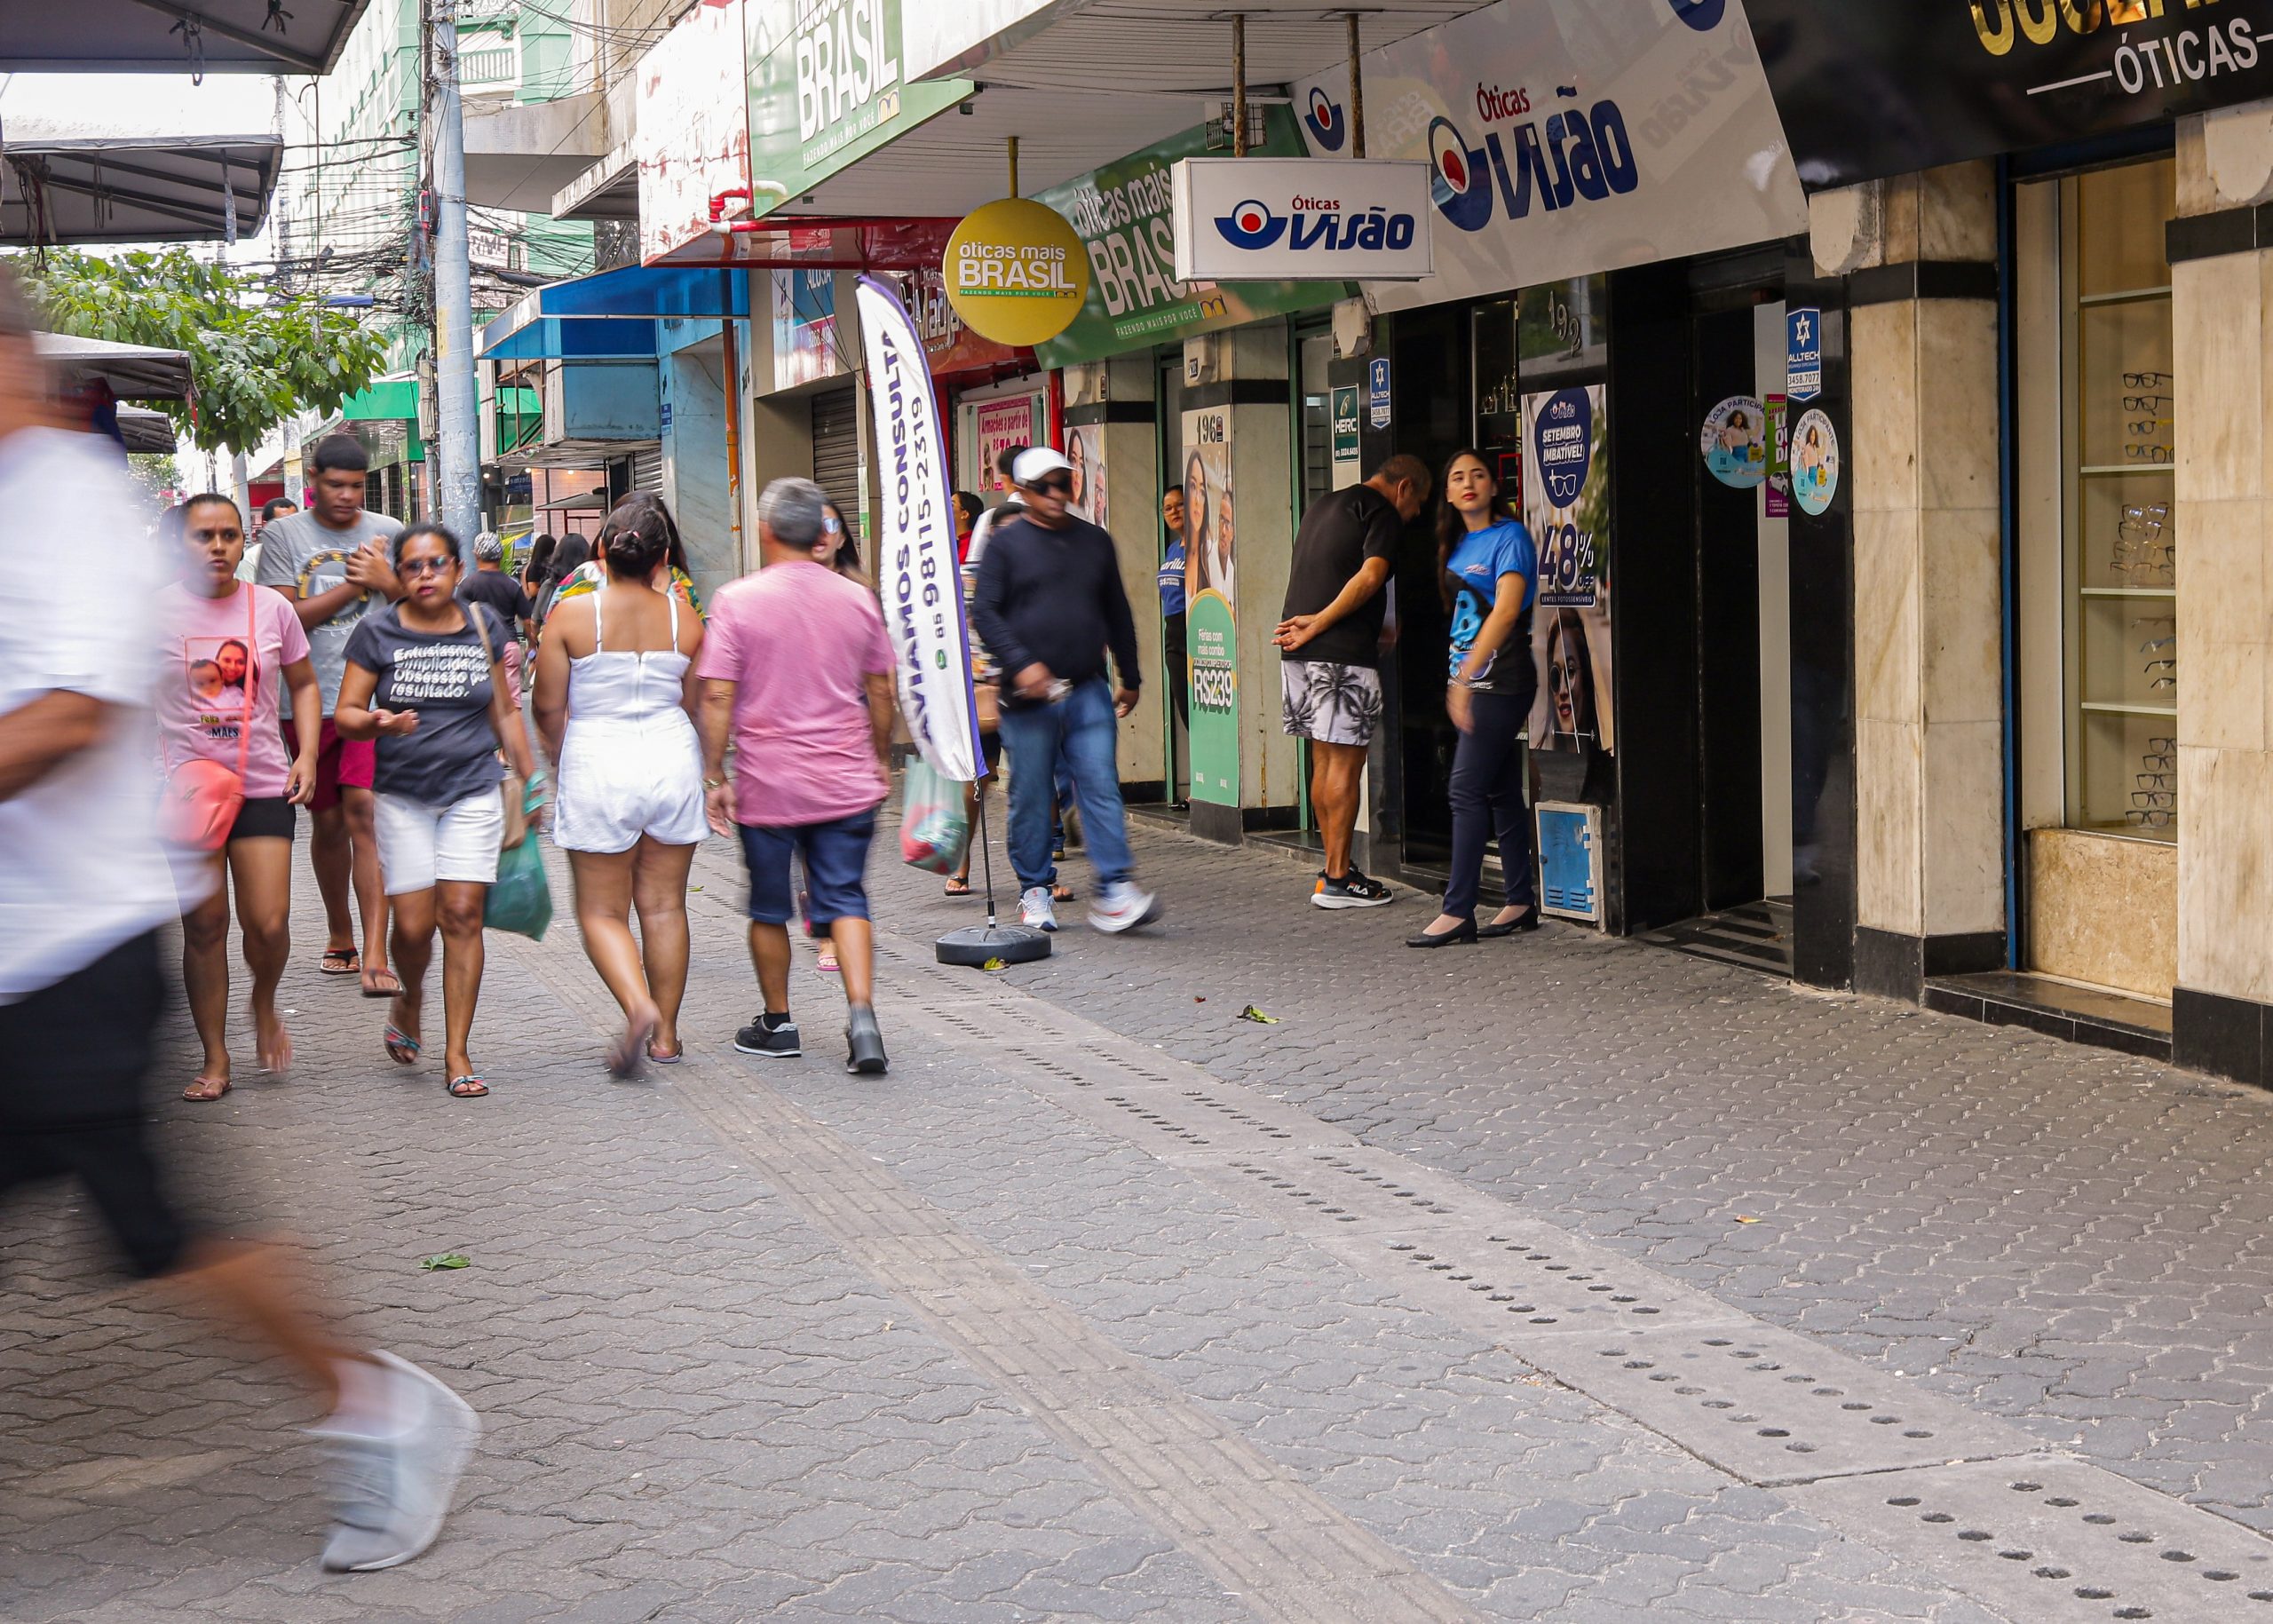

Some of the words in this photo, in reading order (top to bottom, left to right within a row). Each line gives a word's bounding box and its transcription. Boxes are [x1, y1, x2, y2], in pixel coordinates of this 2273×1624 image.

[796, 0, 899, 143] BRASIL
[2114, 18, 2259, 95] ÓTICAS
[1476, 82, 1531, 123] Óticas
[1073, 186, 1131, 238] óticas
[1128, 162, 1174, 219] mais
[1292, 194, 1341, 211] Óticas
[959, 241, 1017, 259] óticas
[1021, 244, 1066, 260] mais
[1087, 213, 1217, 317] BRAS
[959, 258, 1076, 289] BRASIL
[1115, 322, 1146, 337] FAZENDO
[1146, 319, 1164, 331] MAIS
[1163, 314, 1177, 325] POR
[1179, 305, 1198, 321] VOCÊ
[1548, 290, 1581, 358] 192
[1788, 351, 1819, 363] ALLTECH
[1787, 372, 1819, 385] 3458.7077
[1334, 418, 1357, 434] HERC
[1708, 407, 1727, 424] LOJA
[1728, 399, 1765, 415] PARTICIPA
[1543, 424, 1582, 445] SETEMBRO
[1794, 420, 1807, 440] LOJA
[1807, 412, 1836, 446] PARTICIPANTE
[1543, 444, 1584, 463] IMBATÍVEL!
[911, 396, 939, 608] 98115-2319
[1193, 668, 1233, 708] R$239
[1346, 883, 1369, 896] FILA
